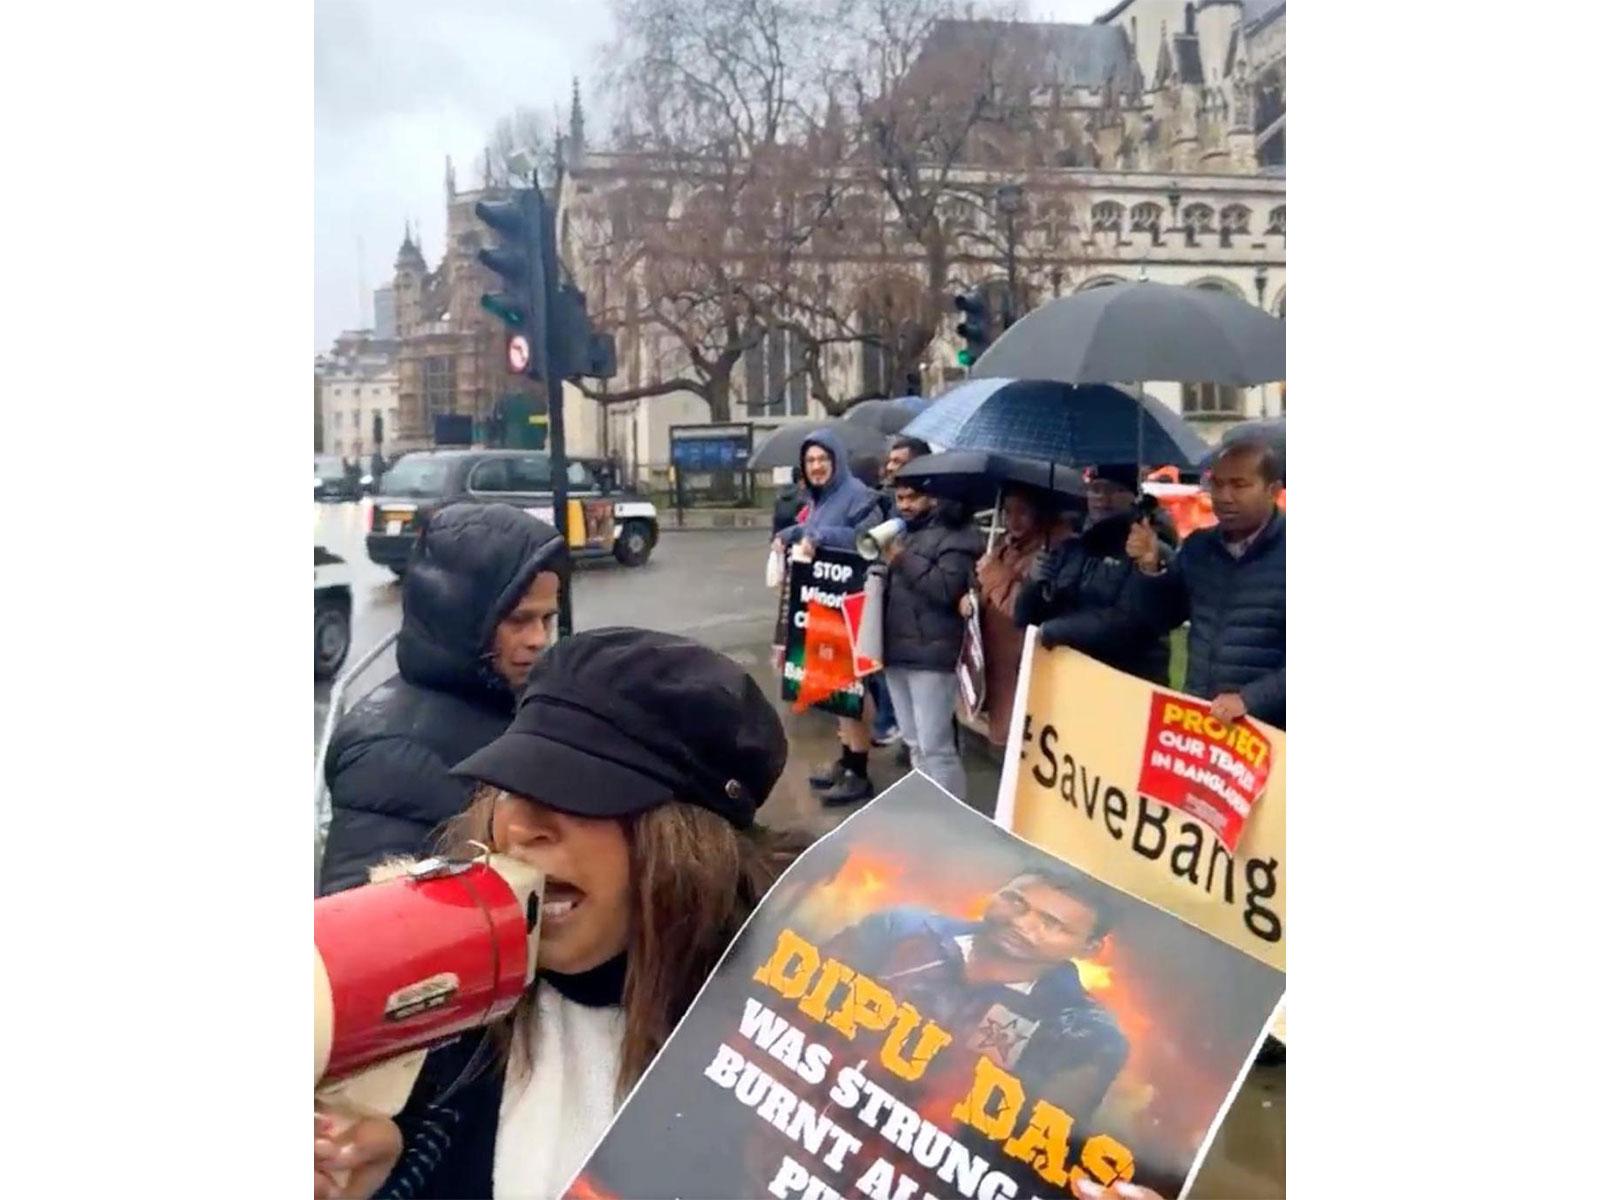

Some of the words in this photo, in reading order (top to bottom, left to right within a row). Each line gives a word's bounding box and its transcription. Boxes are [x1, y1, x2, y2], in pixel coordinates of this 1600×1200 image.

[812, 561, 853, 583] STOP
[1150, 750, 1172, 770] IN
[1158, 729, 1206, 759] OUR
[738, 996, 834, 1085] WAS
[828, 1059, 1018, 1200] STRUNG
[752, 927, 952, 1082] DIPU
[951, 1055, 1135, 1200] DAS
[703, 1042, 863, 1173] BURNT
